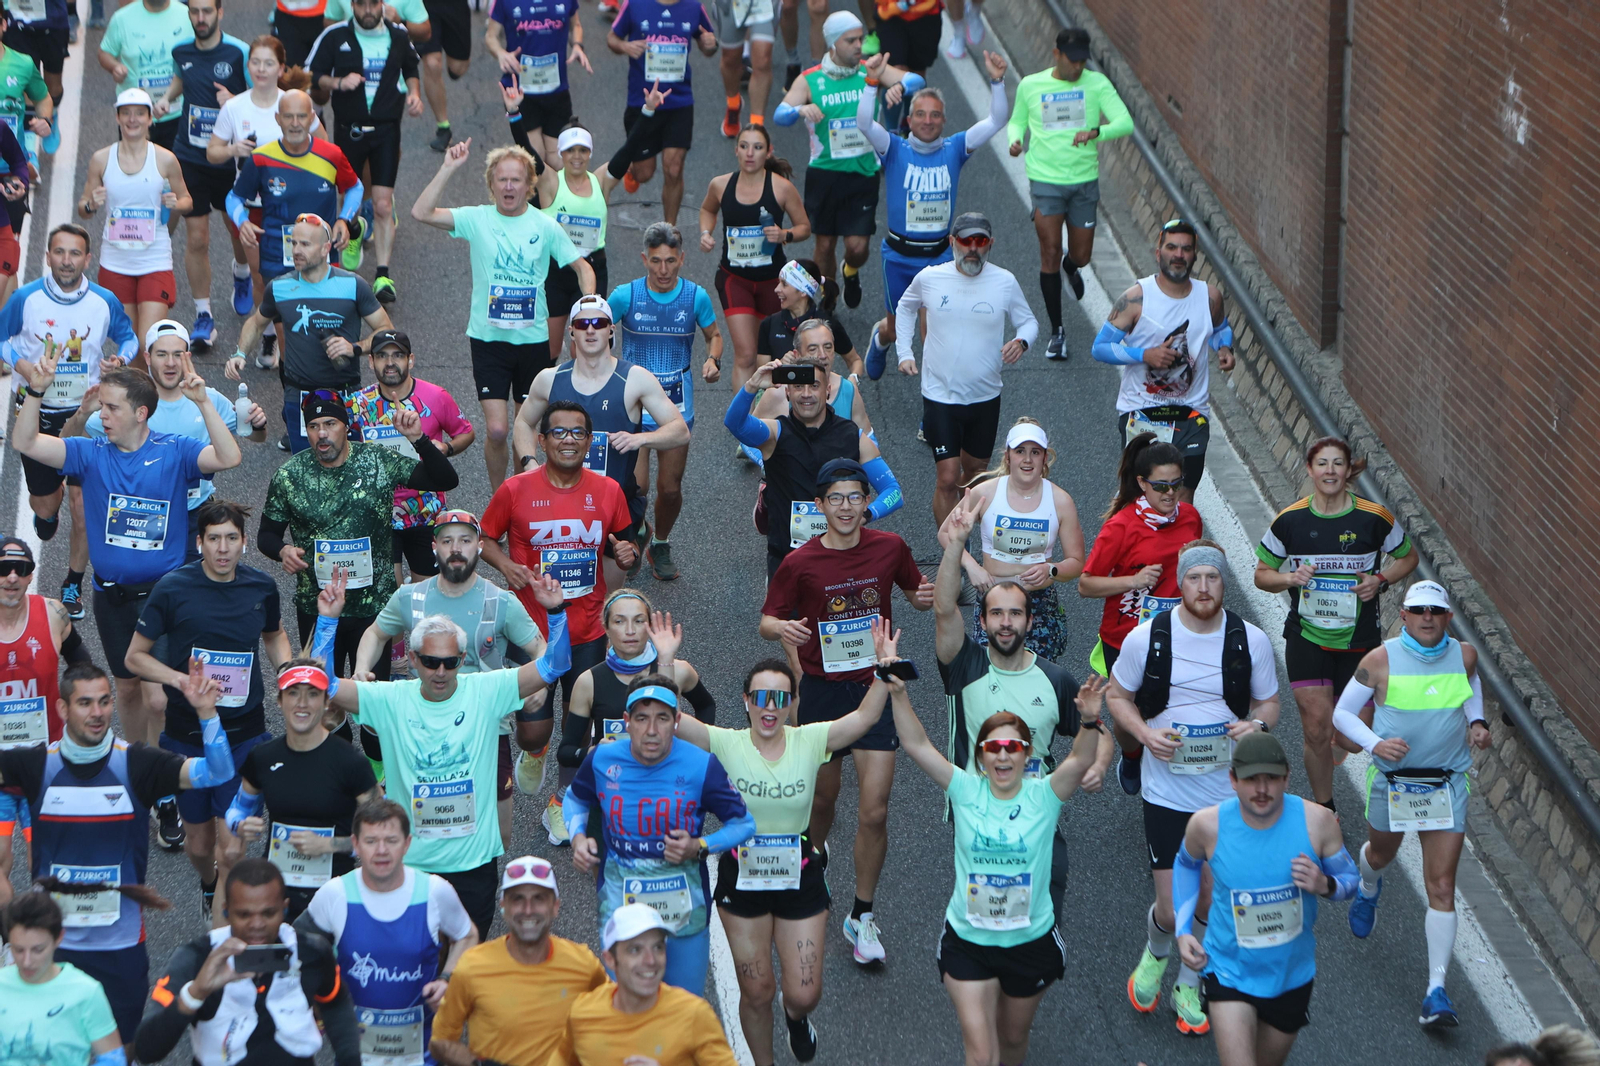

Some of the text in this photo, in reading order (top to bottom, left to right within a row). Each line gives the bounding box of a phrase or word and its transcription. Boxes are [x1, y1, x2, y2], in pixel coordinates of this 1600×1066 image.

[822, 88, 864, 108] PORTUGA
[1056, 92, 1078, 100] ZURICH
[124, 210, 150, 218] ZURICH
[572, 216, 598, 226] ZURICH
[740, 230, 764, 238] ZURICH
[506, 288, 532, 296] ZURICH
[56, 364, 82, 372] ZURICH
[130, 500, 160, 512] ZURICH
[126, 518, 148, 528] 12077
[810, 522, 828, 530] 9463
[1012, 520, 1042, 530] ZURICH
[124, 528, 146, 538] JAVIER
[530, 518, 602, 544] ZDM
[1010, 536, 1032, 546] 10715
[334, 542, 364, 552] ZURICH
[562, 552, 590, 560] ZURICH
[1316, 562, 1364, 570] TERRA ALTA
[560, 570, 582, 578] 11346
[560, 580, 582, 588] PEDRO
[824, 578, 878, 590] BROOKLYN CYCLONES
[1320, 580, 1348, 590] ZURICH
[1316, 598, 1338, 606] 10679
[828, 606, 880, 620] CONEY ISLAND
[842, 620, 872, 631] ZURICH
[840, 638, 864, 648] 10398
[848, 650, 862, 658] TAO
[214, 656, 246, 666] ZURICH
[0, 678, 38, 700] DM
[4, 702, 38, 712] ZURICH
[1192, 726, 1224, 736] ZURICH
[1190, 744, 1214, 752] 10284
[418, 771, 469, 783] SEVILLA'24
[434, 784, 467, 796] ZURICH
[736, 778, 806, 800] adidas
[434, 806, 454, 814] 9068
[422, 816, 470, 826] ANTONIO ROJO
[760, 836, 792, 846] ZURICH
[756, 856, 778, 864] 10671
[974, 856, 1026, 864] SEVILLA'24
[74, 870, 110, 880] ZURICH
[770, 868, 790, 876] ÑAÑA
[646, 880, 680, 890] ZURICH
[992, 878, 1022, 886] ZURICH
[1256, 890, 1292, 902] ZURICH
[1258, 924, 1284, 934] CAMPO
[374, 964, 424, 982] mind
[380, 1012, 416, 1024] ZURICH
